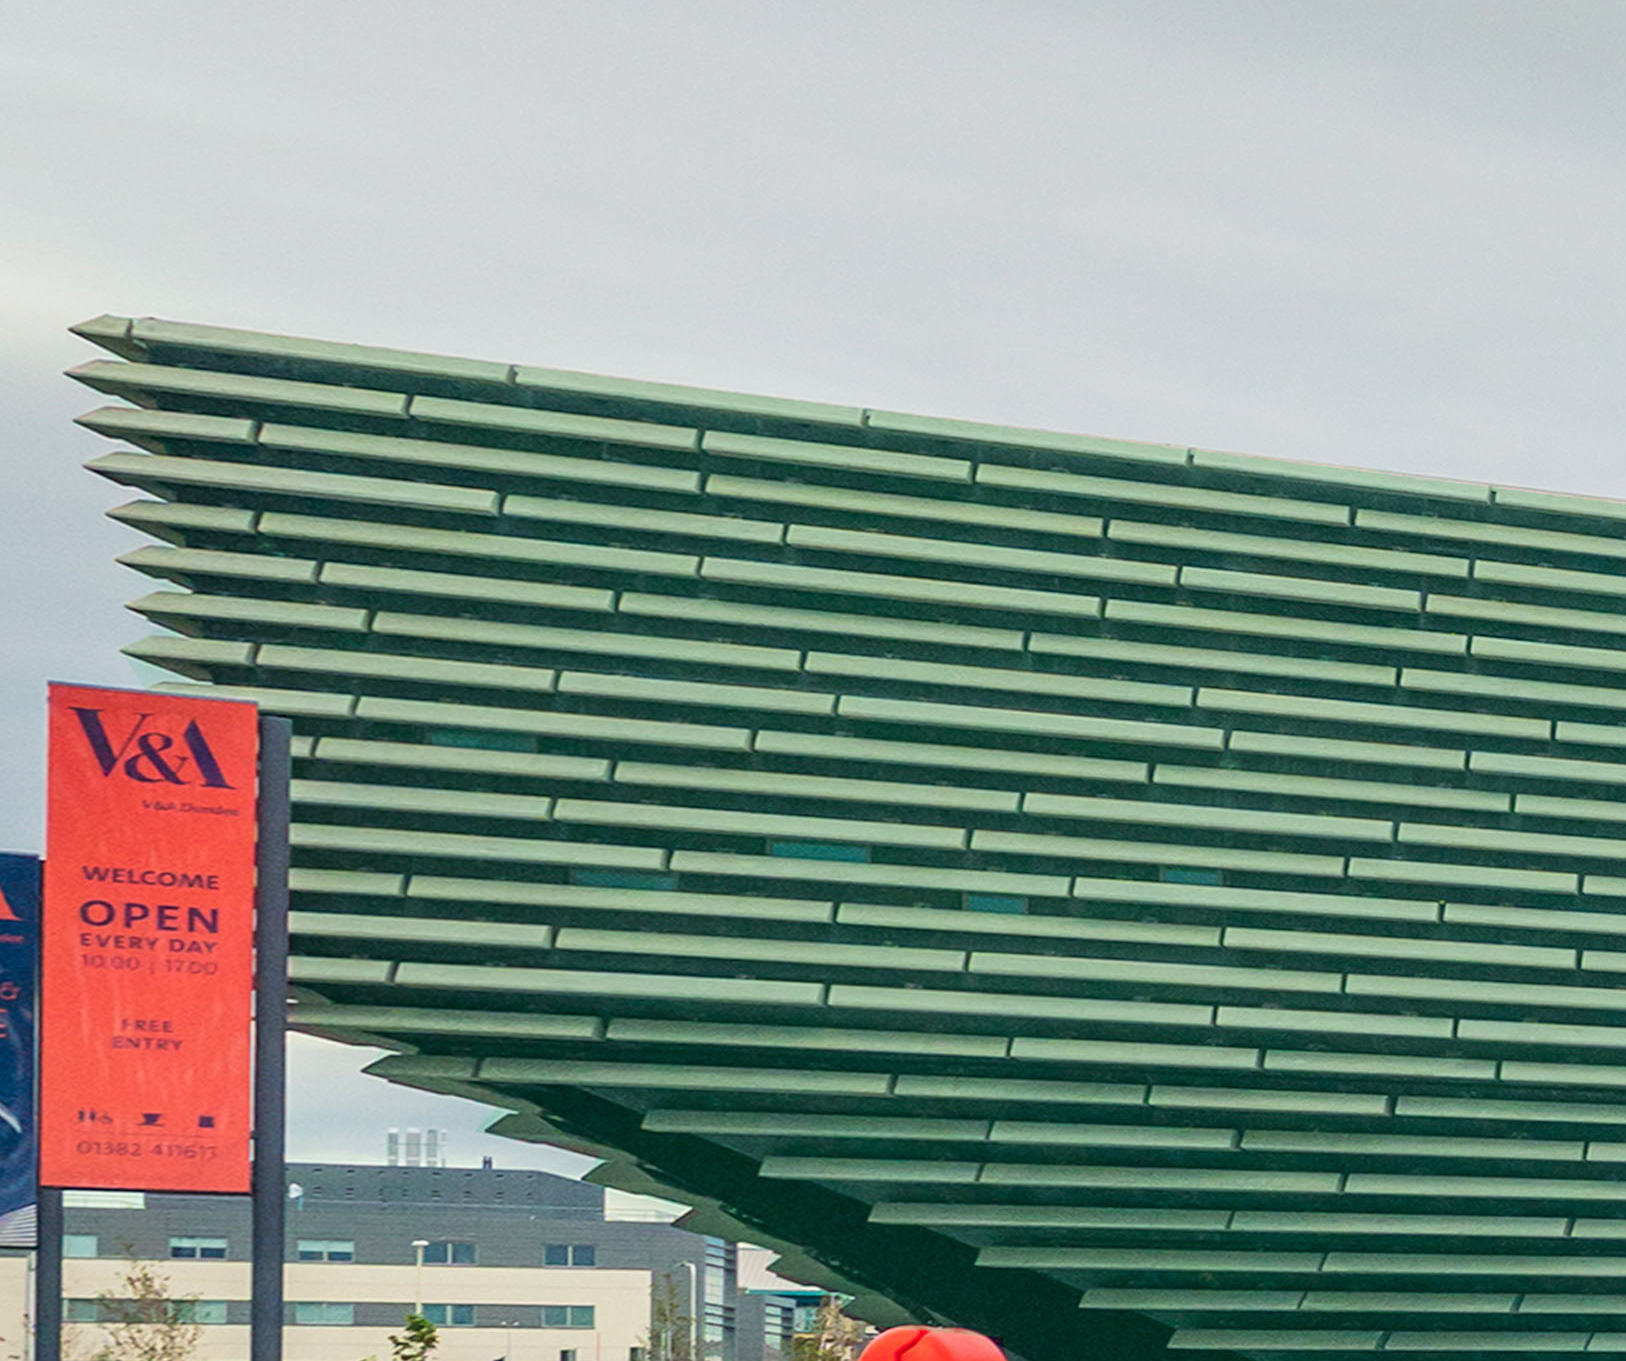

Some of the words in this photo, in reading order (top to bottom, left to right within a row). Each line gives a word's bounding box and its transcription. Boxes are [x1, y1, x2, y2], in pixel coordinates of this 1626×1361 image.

[67, 705, 238, 791] V&A
[82, 866, 221, 890] WELCOME
[79, 900, 219, 933] OPEN
[79, 933, 158, 951] EVERY
[168, 939, 218, 953] DAY
[121, 1018, 175, 1034] FREE
[111, 1035, 184, 1051] ENTRY
